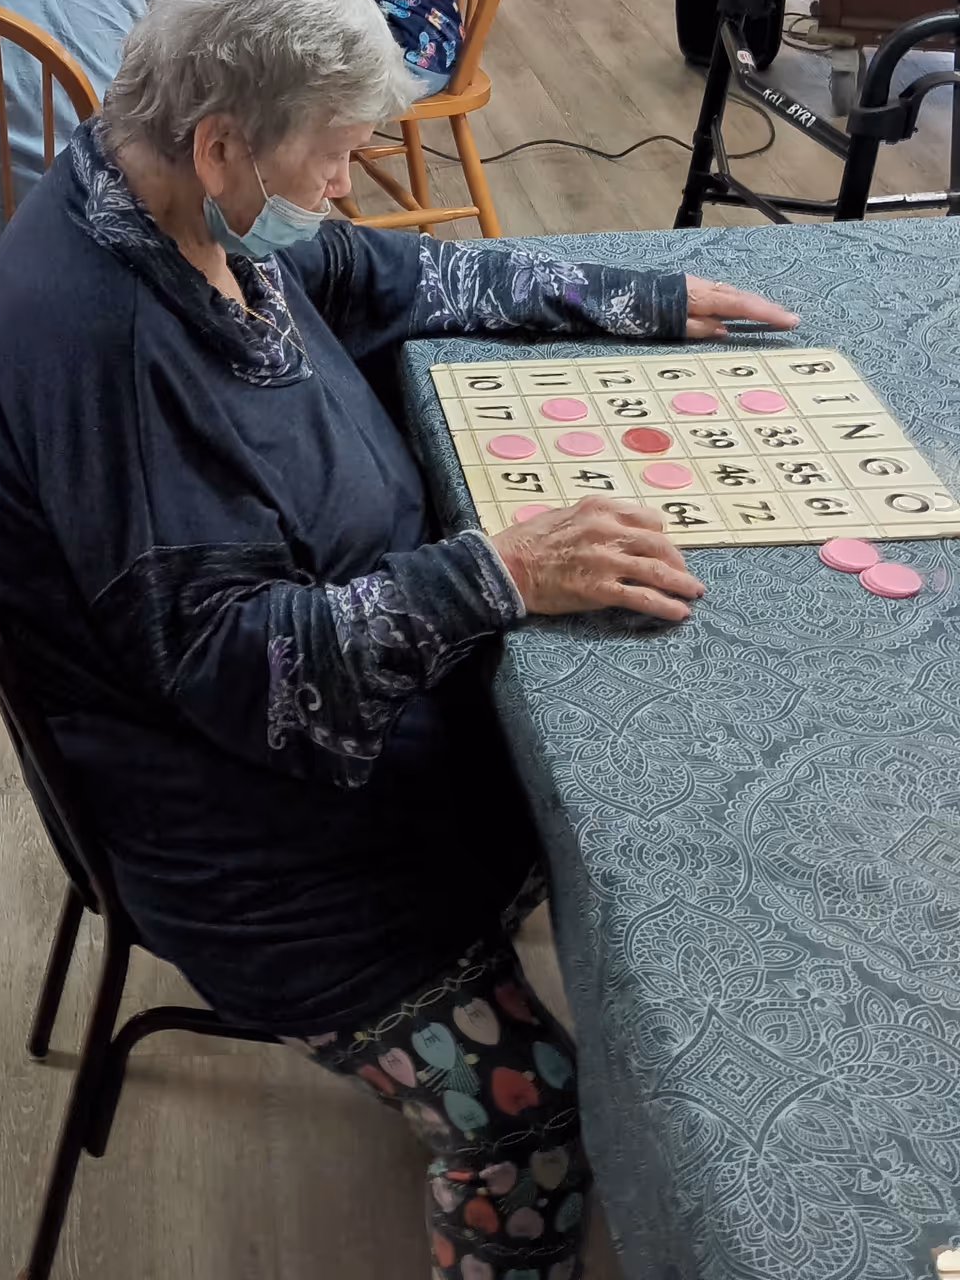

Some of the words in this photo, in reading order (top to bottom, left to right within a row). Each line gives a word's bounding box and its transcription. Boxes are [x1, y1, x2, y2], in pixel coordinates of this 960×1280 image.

[592, 369, 636, 389] 12
[657, 368, 696, 381] 6
[716, 364, 758, 378] 9
[464, 375, 504, 391] 10
[474, 405, 516, 421] 17
[607, 397, 651, 418] 30
[528, 372, 572, 386] 11
[570, 468, 616, 492] 47
[689, 425, 739, 449] 39
[754, 425, 804, 448] 33
[501, 471, 547, 494] 57
[710, 463, 760, 487] 46
[775, 460, 832, 486] 55
[661, 501, 711, 529] 64
[732, 500, 778, 525] 72
[804, 496, 852, 517] 61
